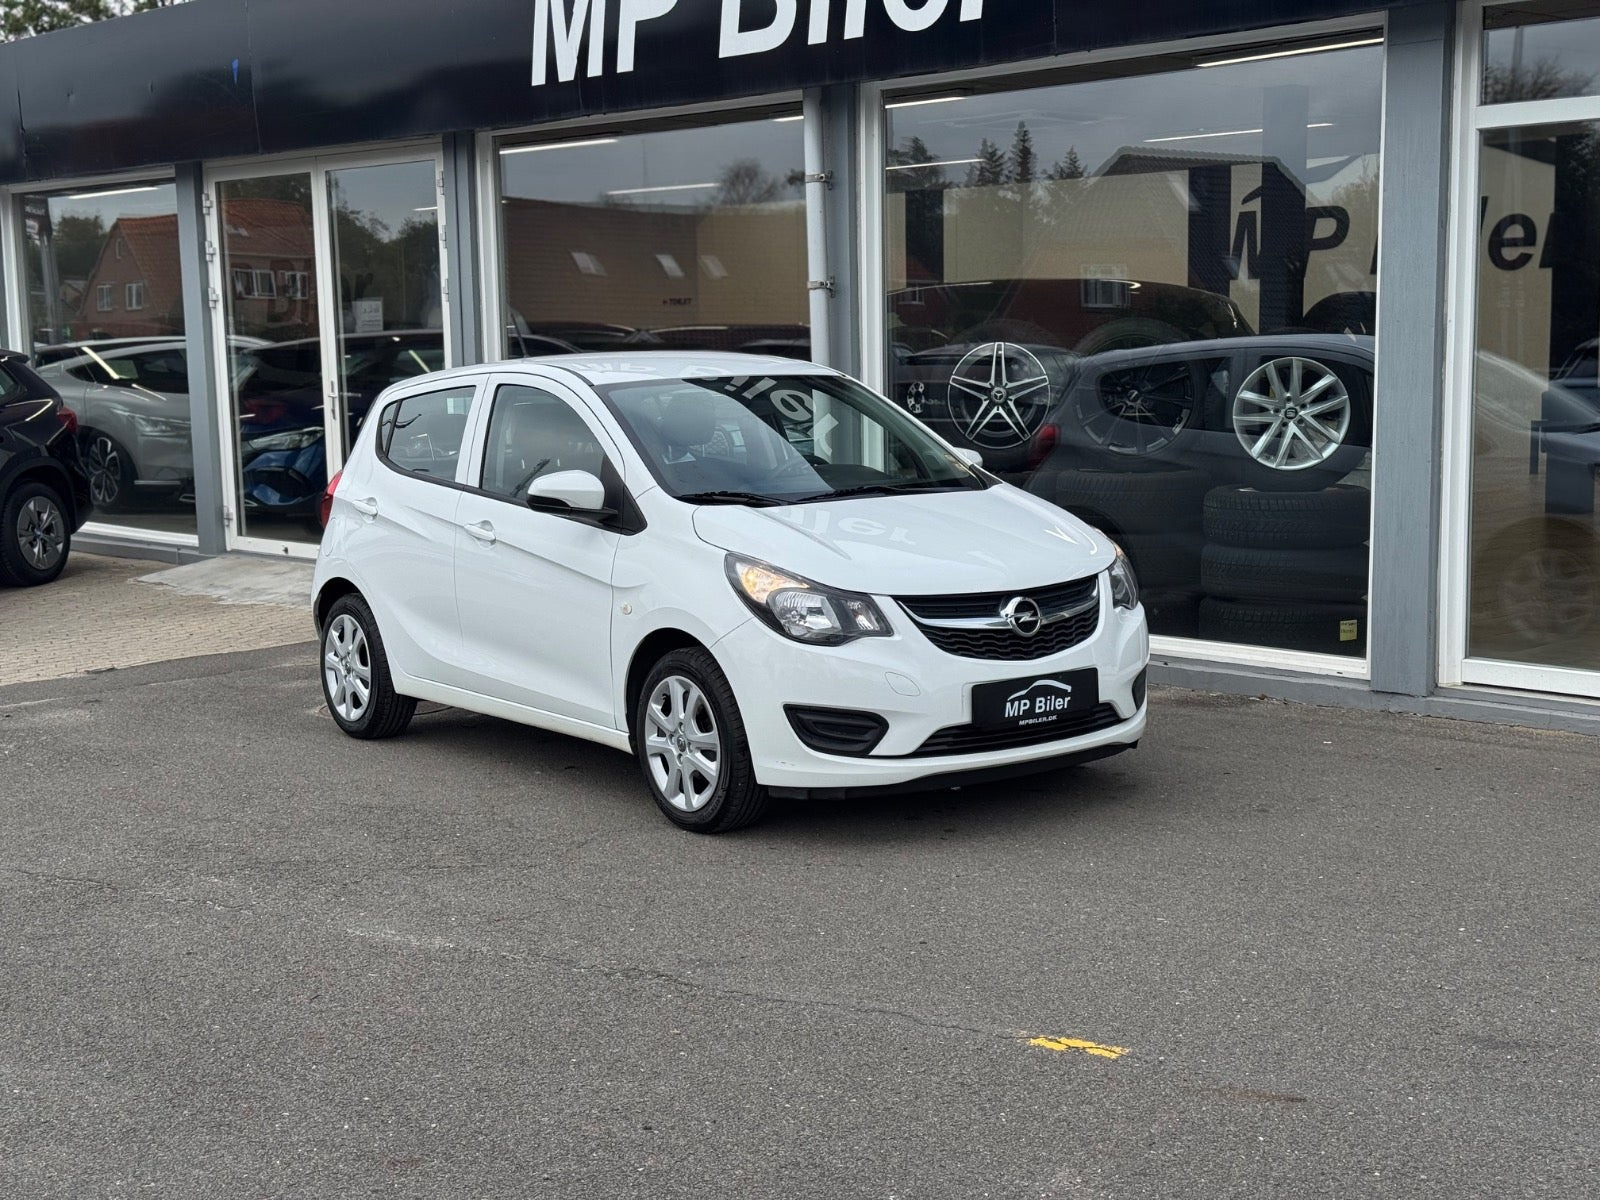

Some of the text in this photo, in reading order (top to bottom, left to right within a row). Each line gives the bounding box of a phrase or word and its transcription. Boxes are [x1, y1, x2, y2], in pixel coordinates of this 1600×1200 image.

[1005, 695, 1071, 717] MP Biler
[1018, 715, 1057, 725] MPBILER.DK
